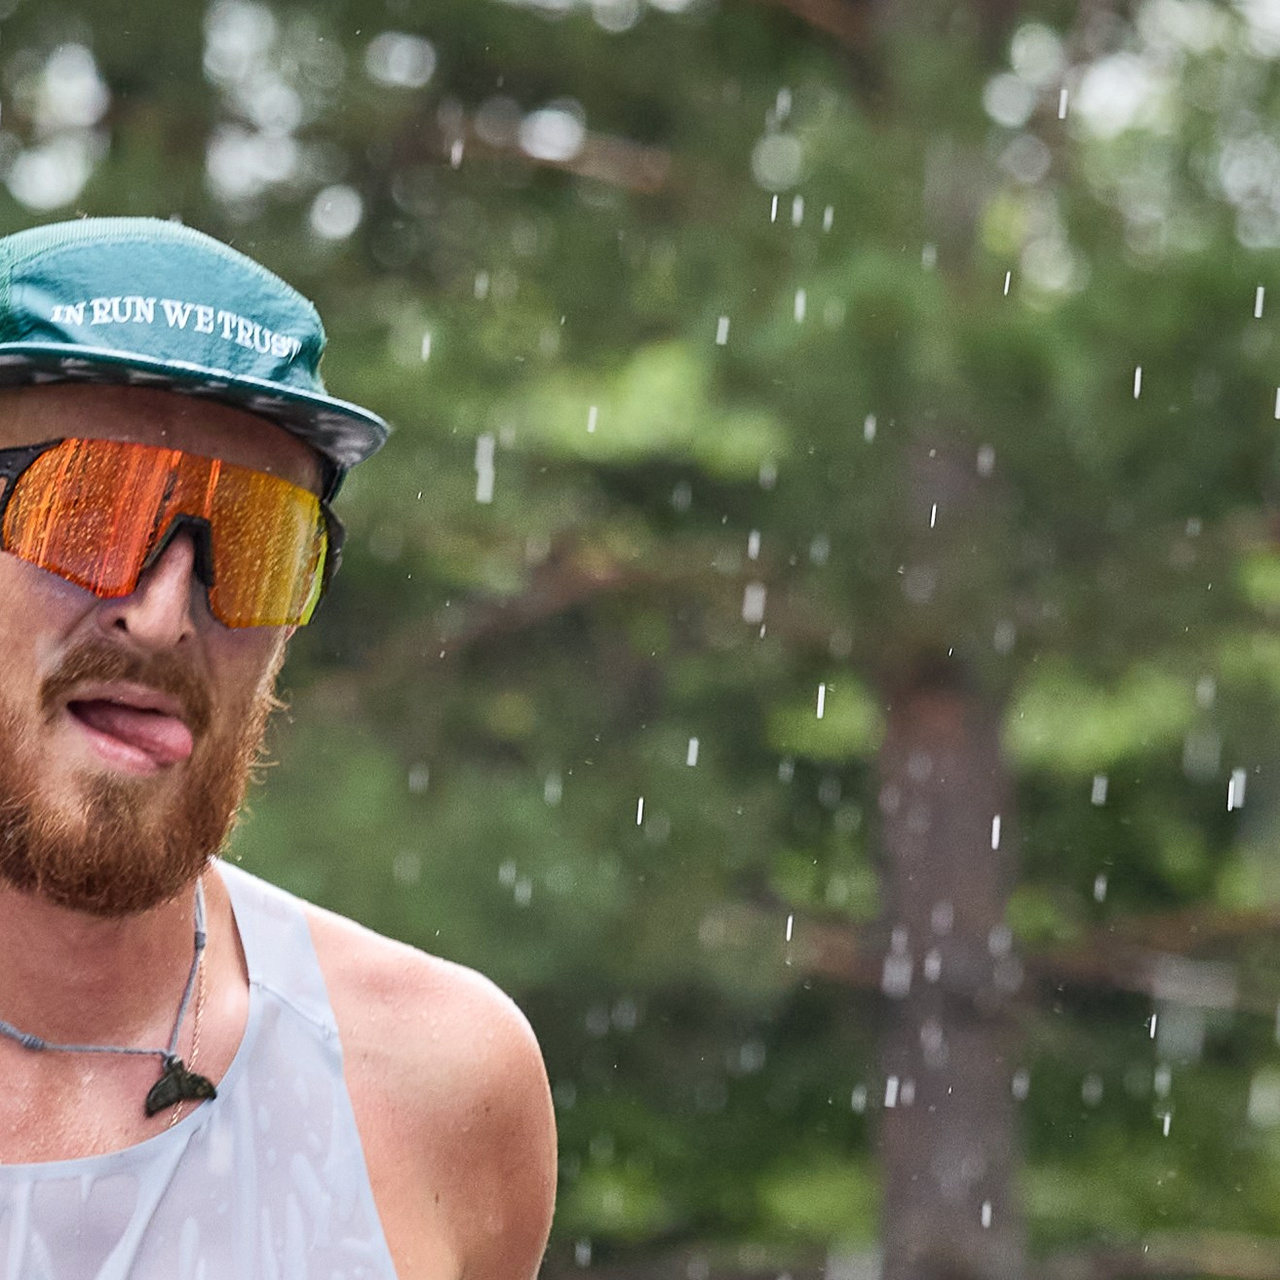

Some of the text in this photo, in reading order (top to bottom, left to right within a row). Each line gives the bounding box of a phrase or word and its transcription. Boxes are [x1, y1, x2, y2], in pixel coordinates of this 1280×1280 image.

[51, 296, 303, 364] IN RUN WE TRUST
